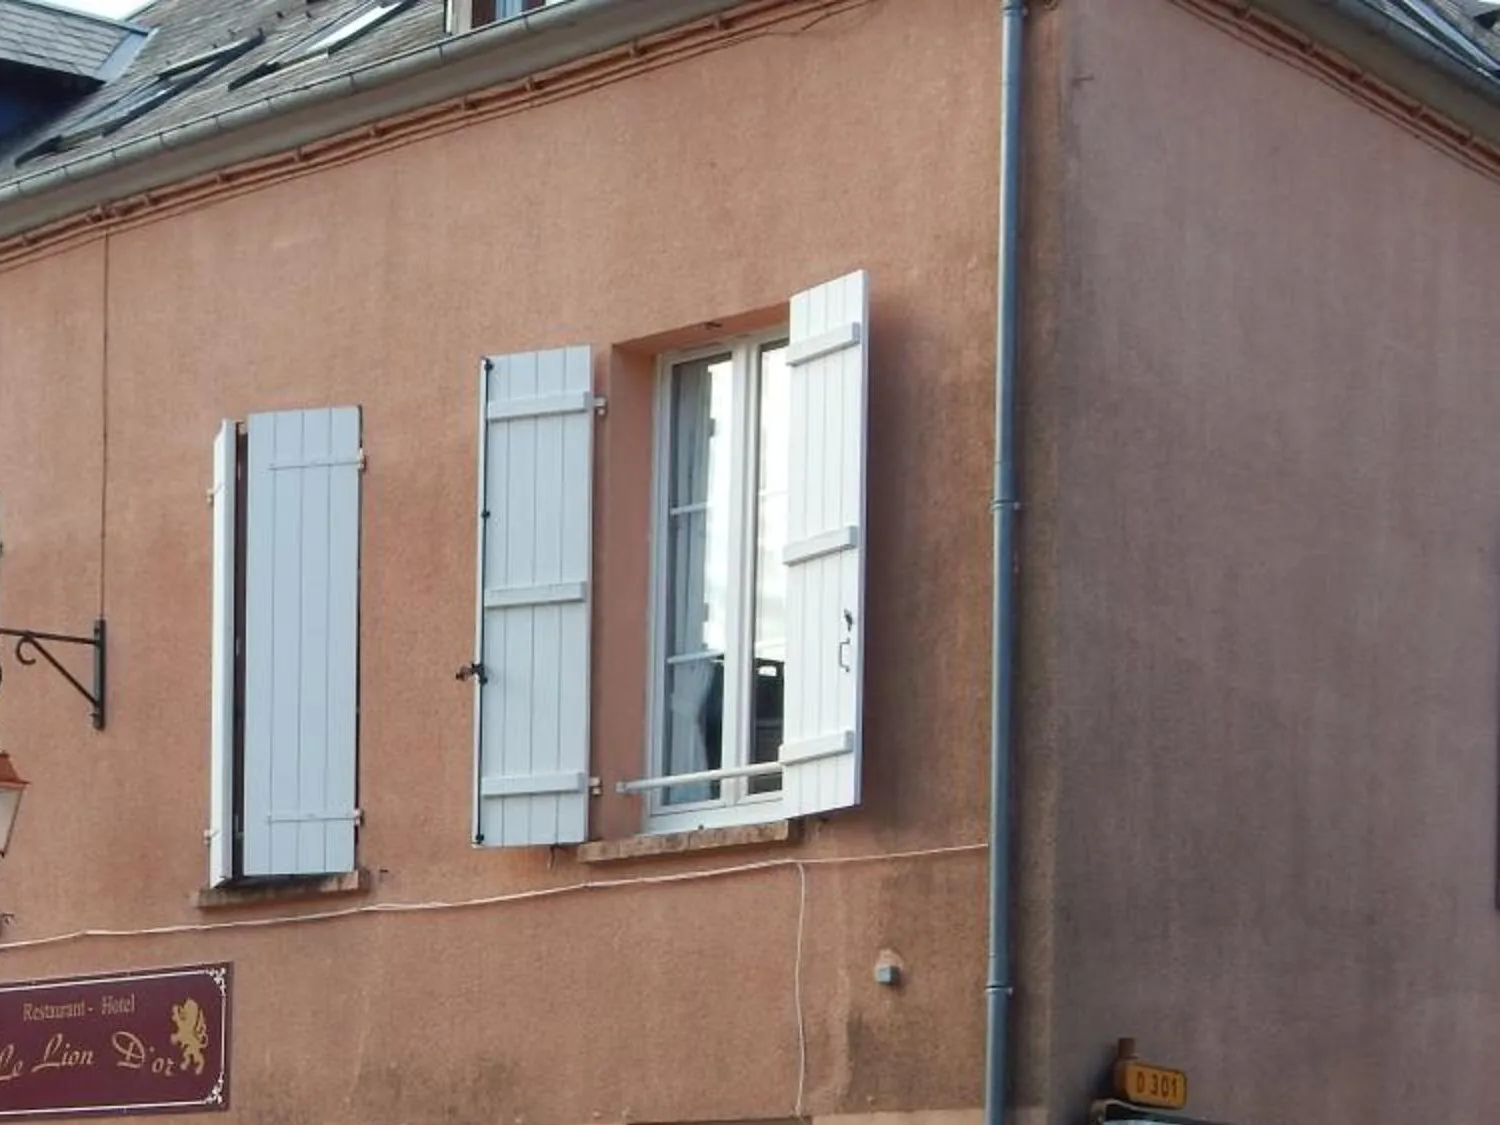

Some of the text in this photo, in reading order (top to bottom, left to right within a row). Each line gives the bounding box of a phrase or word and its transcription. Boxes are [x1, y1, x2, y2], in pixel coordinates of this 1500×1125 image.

[23, 1000, 86, 1021] Restaurant
[31, 1033, 95, 1072] Lion
[1136, 1071, 1178, 1099] D 301
